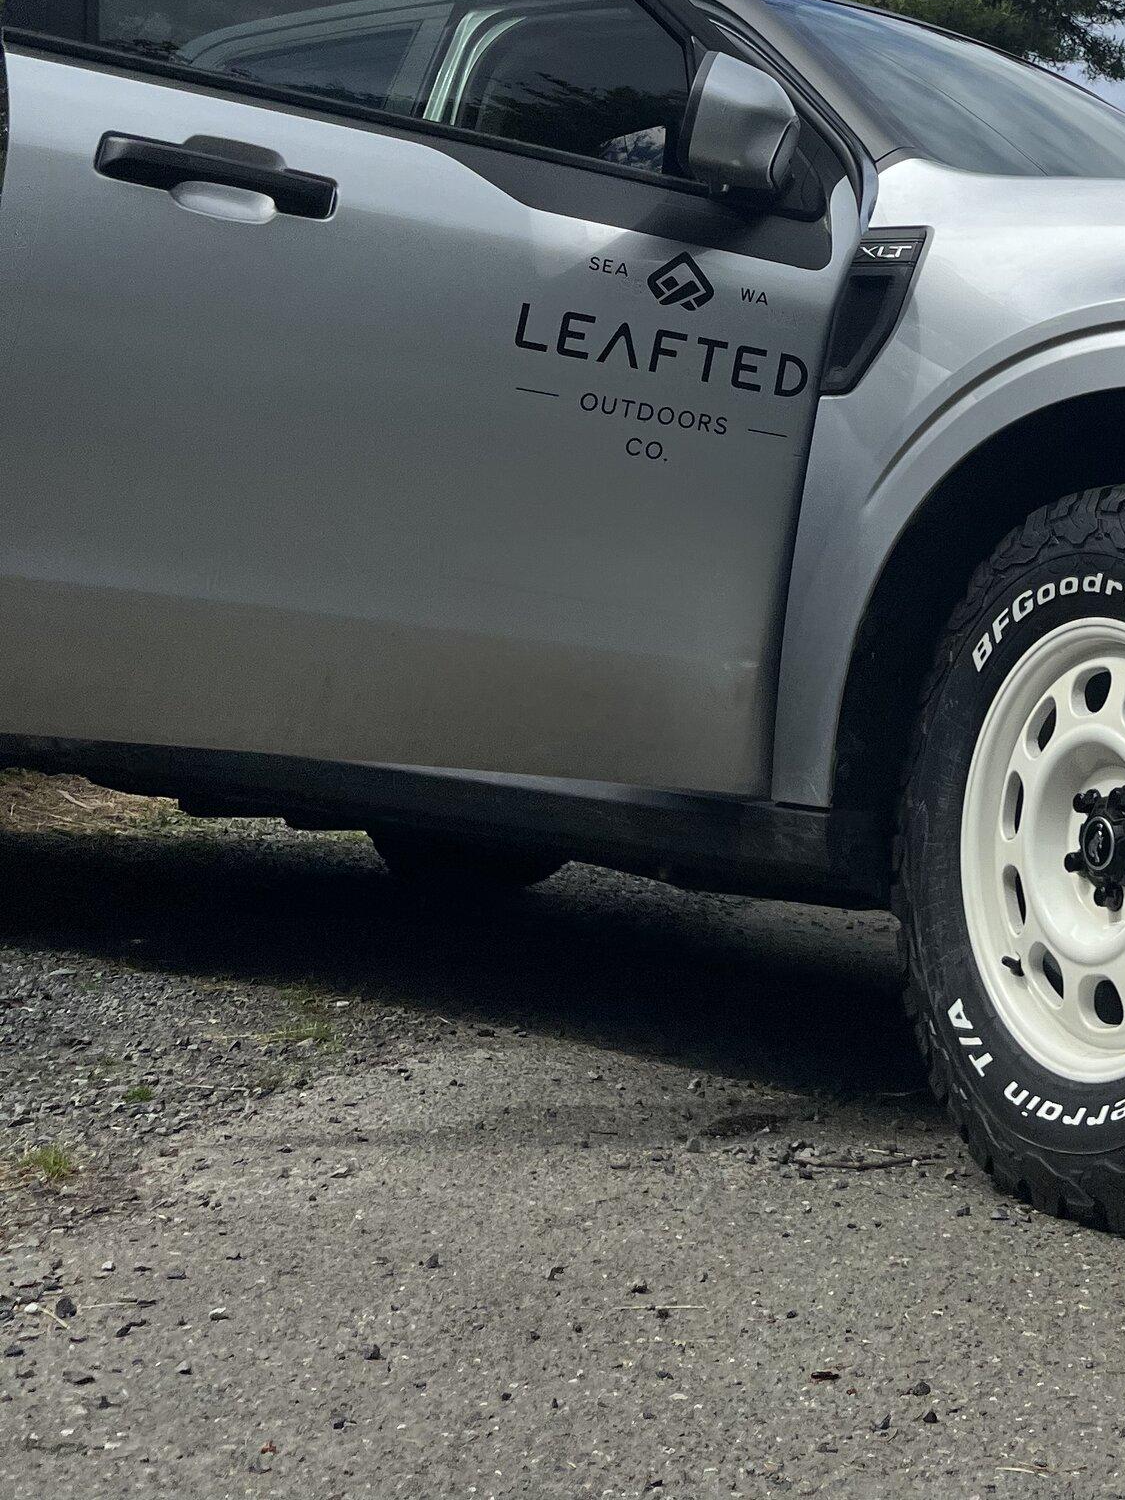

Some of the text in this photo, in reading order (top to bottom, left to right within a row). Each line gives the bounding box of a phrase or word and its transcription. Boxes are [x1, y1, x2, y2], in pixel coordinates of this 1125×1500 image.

[860, 245, 913, 258] XLT
[588, 255, 769, 307] SEA WA
[514, 302, 808, 397] LEAFTED
[579, 392, 728, 435] OUTDOORS
[625, 437, 668, 462] CO.
[947, 998, 994, 1077] T/A
